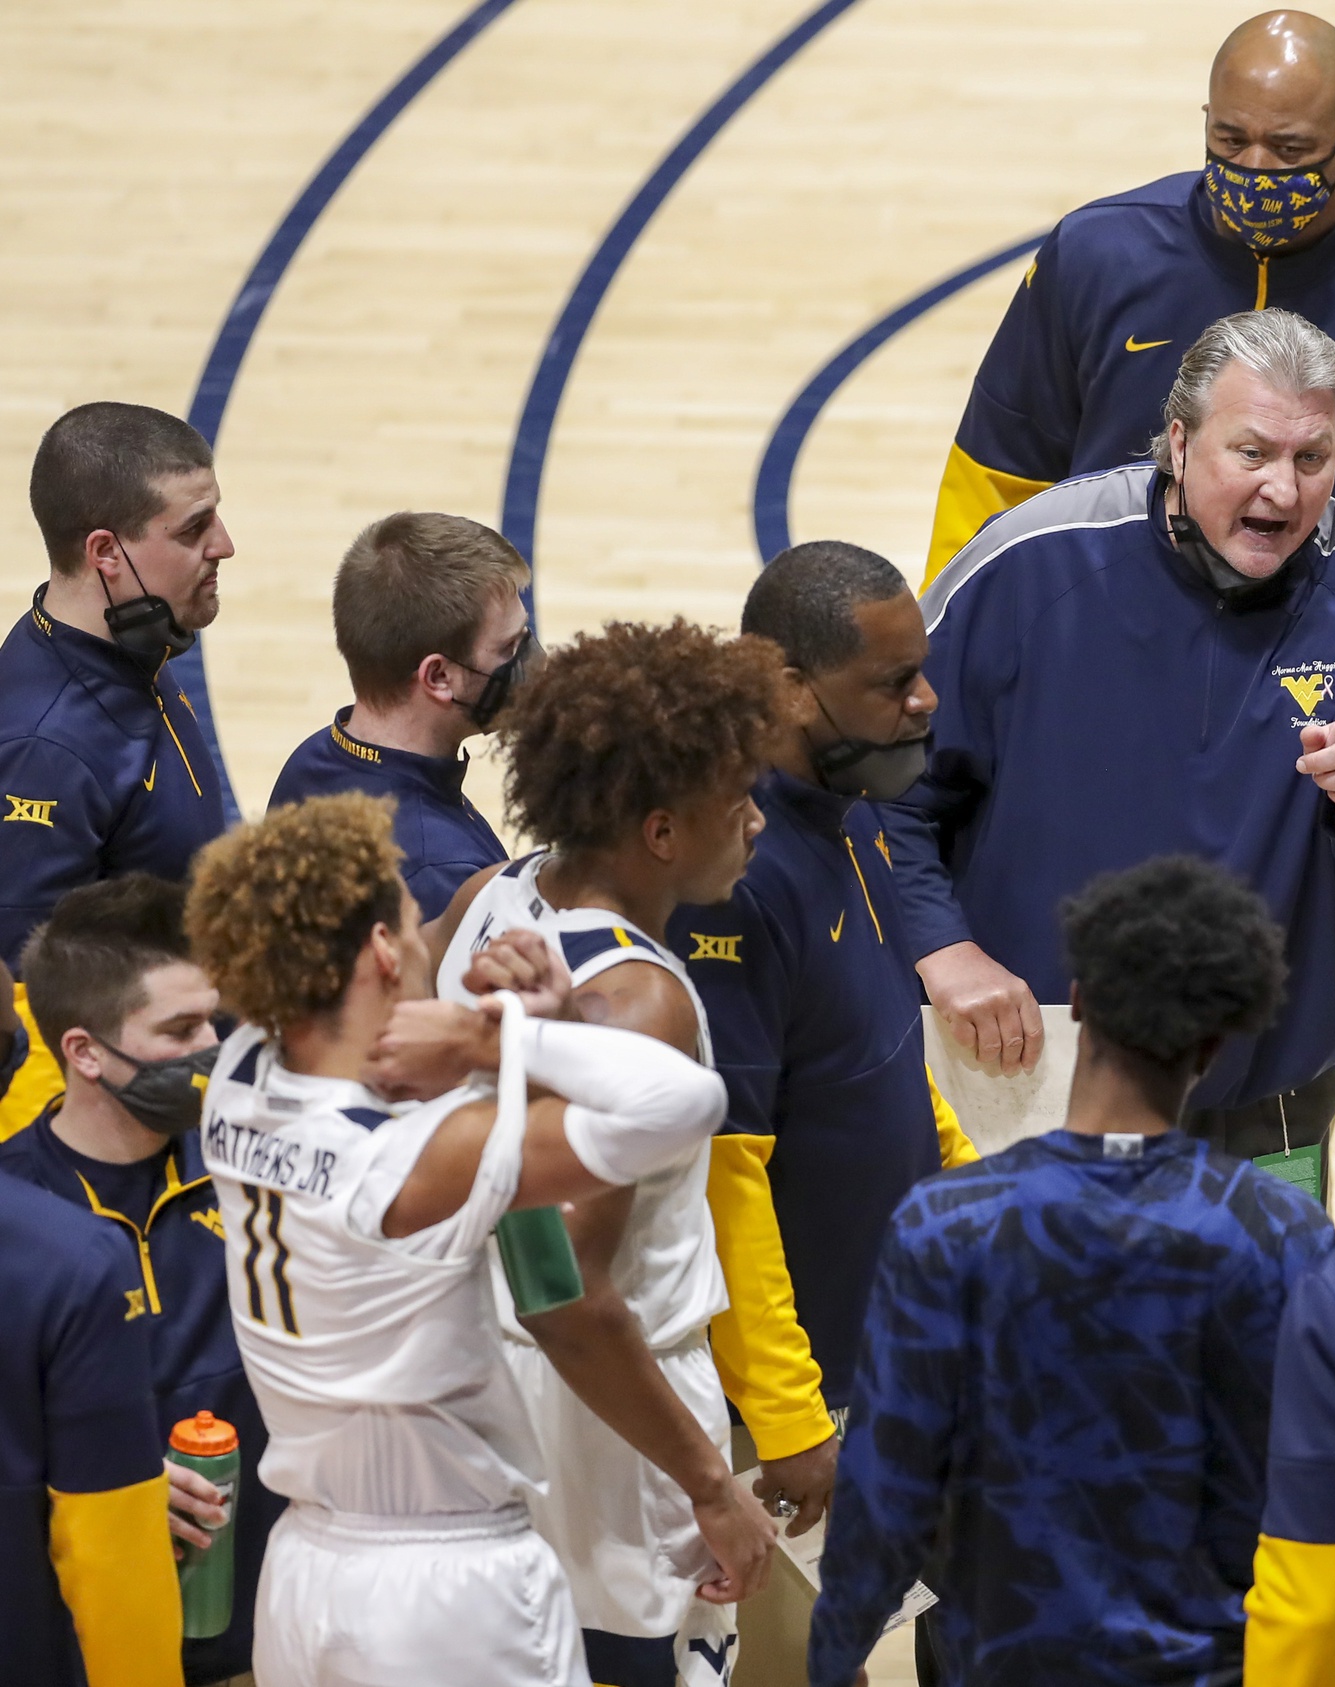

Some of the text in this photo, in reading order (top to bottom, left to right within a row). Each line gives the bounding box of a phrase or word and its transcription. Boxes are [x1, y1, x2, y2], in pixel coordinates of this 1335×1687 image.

[1261, 198, 1283, 214] WVU
[1252, 231, 1273, 247] WVU
[1290, 716, 1327, 729] Foundation
[206, 1109, 336, 1201] MATTHEWS JR.
[240, 1181, 302, 1341] 11
